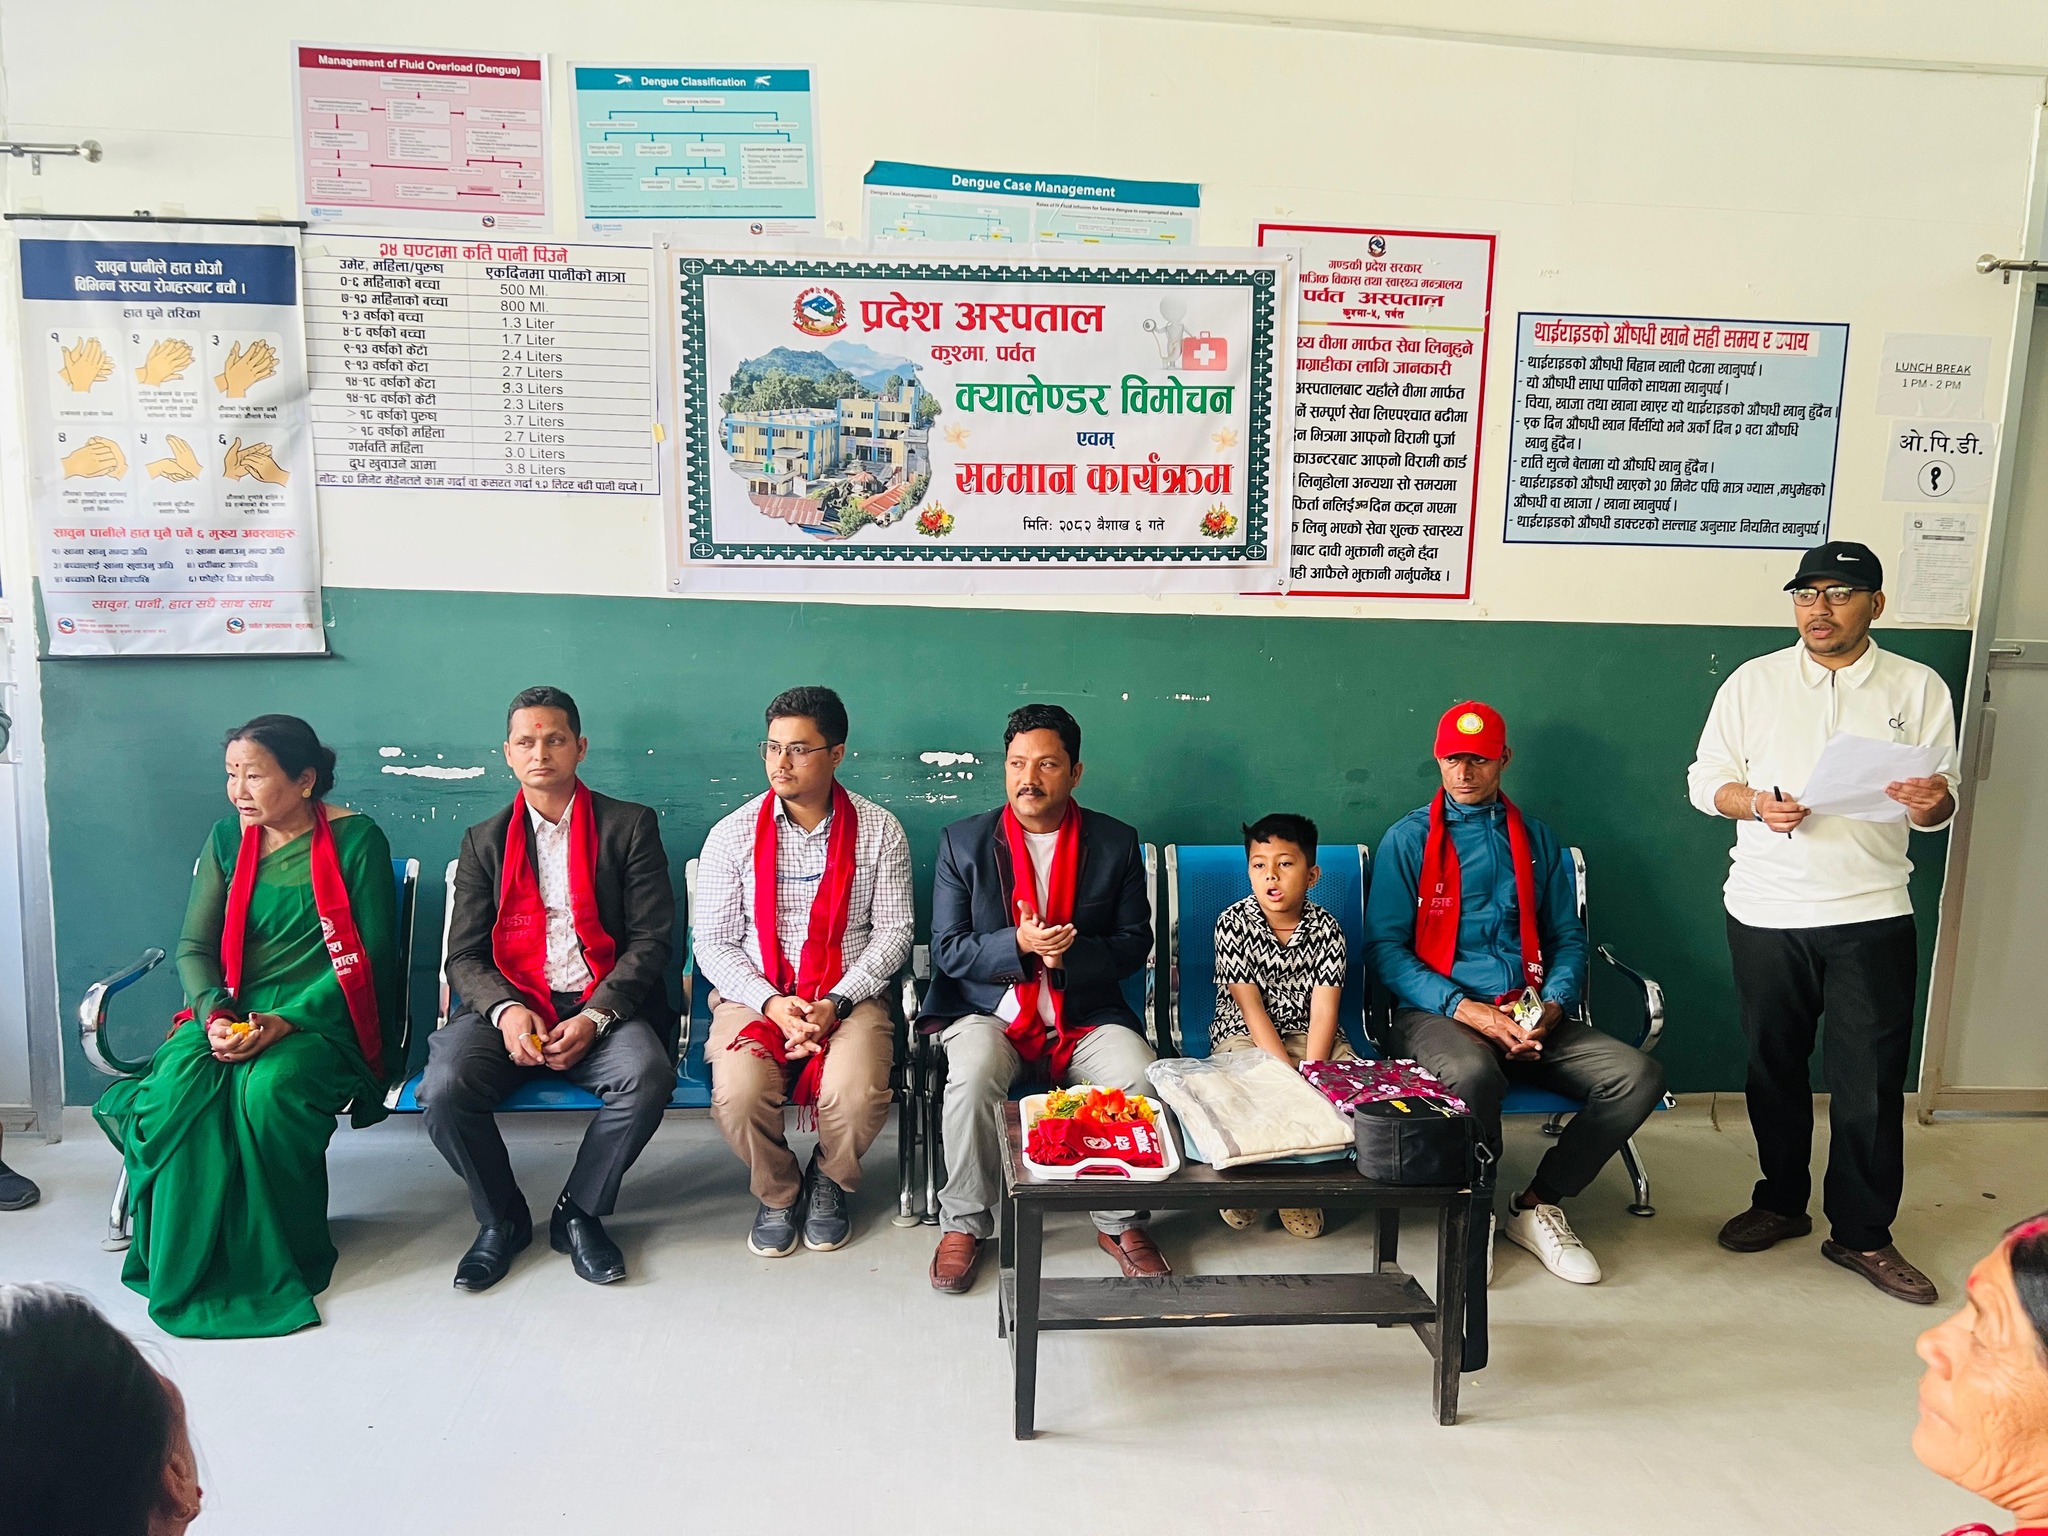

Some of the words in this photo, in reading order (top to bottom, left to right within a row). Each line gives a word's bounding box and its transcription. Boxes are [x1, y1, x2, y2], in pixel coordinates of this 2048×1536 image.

[318, 54, 384, 69] Management
[387, 58, 398, 68] of
[399, 58, 424, 70] Fluid
[427, 60, 473, 72] Overload
[475, 63, 521, 76] (Dengue)
[641, 77, 678, 88] Dengue
[681, 77, 746, 86] Classification
[952, 175, 1000, 190] Dengue
[1003, 179, 1032, 191] Case
[1035, 181, 1115, 197] Management
[380, 244, 397, 260] २४
[404, 244, 457, 259] घण्टामा
[463, 245, 492, 260] कति
[497, 246, 528, 261] पानी
[533, 247, 568, 263] पिउने
[486, 266, 544, 280] एकदिनमा
[549, 268, 591, 281] पानीको
[596, 272, 626, 282] मात्रा
[1329, 260, 1362, 270] गण्डकी
[1366, 261, 1386, 272] प्रदेश
[1390, 264, 1422, 273] सरकार
[1304, 287, 1345, 303] पर्वत
[1359, 292, 1444, 307] अस्पताल
[124, 309, 142, 318] हात
[168, 307, 200, 318] तरिका
[343, 310, 359, 320] १-३
[364, 309, 394, 321] वर्षको
[399, 312, 423, 322] बच्चा
[860, 292, 943, 332] प्रदेश
[955, 303, 1105, 333] अस्पताल
[51, 333, 59, 342] १
[133, 334, 139, 344] २
[213, 335, 219, 346] ३
[1535, 320, 1610, 344] थाईराइडको
[1614, 322, 1657, 345] औषधी
[1661, 325, 1690, 346] खाने
[1694, 325, 1720, 348] सही
[1724, 330, 1760, 349] समय
[1763, 332, 1773, 348] र
[931, 346, 988, 365] कुश्मा,
[996, 342, 1035, 362] पर्वत
[1319, 334, 1348, 350] वीमा
[1352, 336, 1392, 352] मार्फत
[1396, 337, 1421, 353] सेवा
[1425, 338, 1473, 357] लिनुहुने
[503, 350, 521, 360] 2.4
[527, 351, 562, 362] Liters
[503, 366, 522, 377] 2.7
[528, 367, 562, 378] Liters
[1356, 358, 1389, 373] लागि
[1393, 360, 1452, 376] जानकारी
[1895, 362, 1933, 373] LUNCH
[1936, 363, 1971, 375] BREAK
[1296, 382, 1363, 395] अस्पतालबाट
[1366, 384, 1399, 397] यहाँले
[1403, 384, 1427, 397] वीमा
[1431, 386, 1465, 399] मार्फत
[1911, 379, 1927, 387] PM
[1945, 381, 1961, 389] PM
[956, 374, 1111, 415] क्यालेण्डर
[1121, 374, 1235, 414] विमोचन
[1556, 398, 1584, 410] खाजा
[1587, 399, 1608, 410] तथा
[1611, 400, 1638, 411] खाना
[1641, 401, 1668, 413] खाएर
[1672, 400, 1684, 413] यो
[1687, 400, 1745, 415] थाईराइडको
[1747, 401, 1780, 416] औषधी
[219, 434, 226, 445] ६
[1077, 432, 1115, 449] एवम्
[1900, 429, 1982, 455] ओ.पि.डी.
[506, 463, 525, 474] 3.8
[531, 464, 565, 475] Liters
[955, 464, 1076, 494] सम्मान
[1087, 454, 1232, 494] कार्यक्रम
[1931, 467, 1941, 491] १
[1060, 521, 1091, 531] २०८२
[1136, 521, 1141, 532] ६
[1149, 517, 1165, 530] गते
[1303, 518, 1327, 537] लिनु
[1330, 520, 1363, 534] भएको
[1366, 520, 1387, 535] सेवा
[1390, 524, 1420, 538] शुल्क
[1423, 525, 1463, 537] स्वास्थ्य
[1889, 713, 1905, 731] ck
